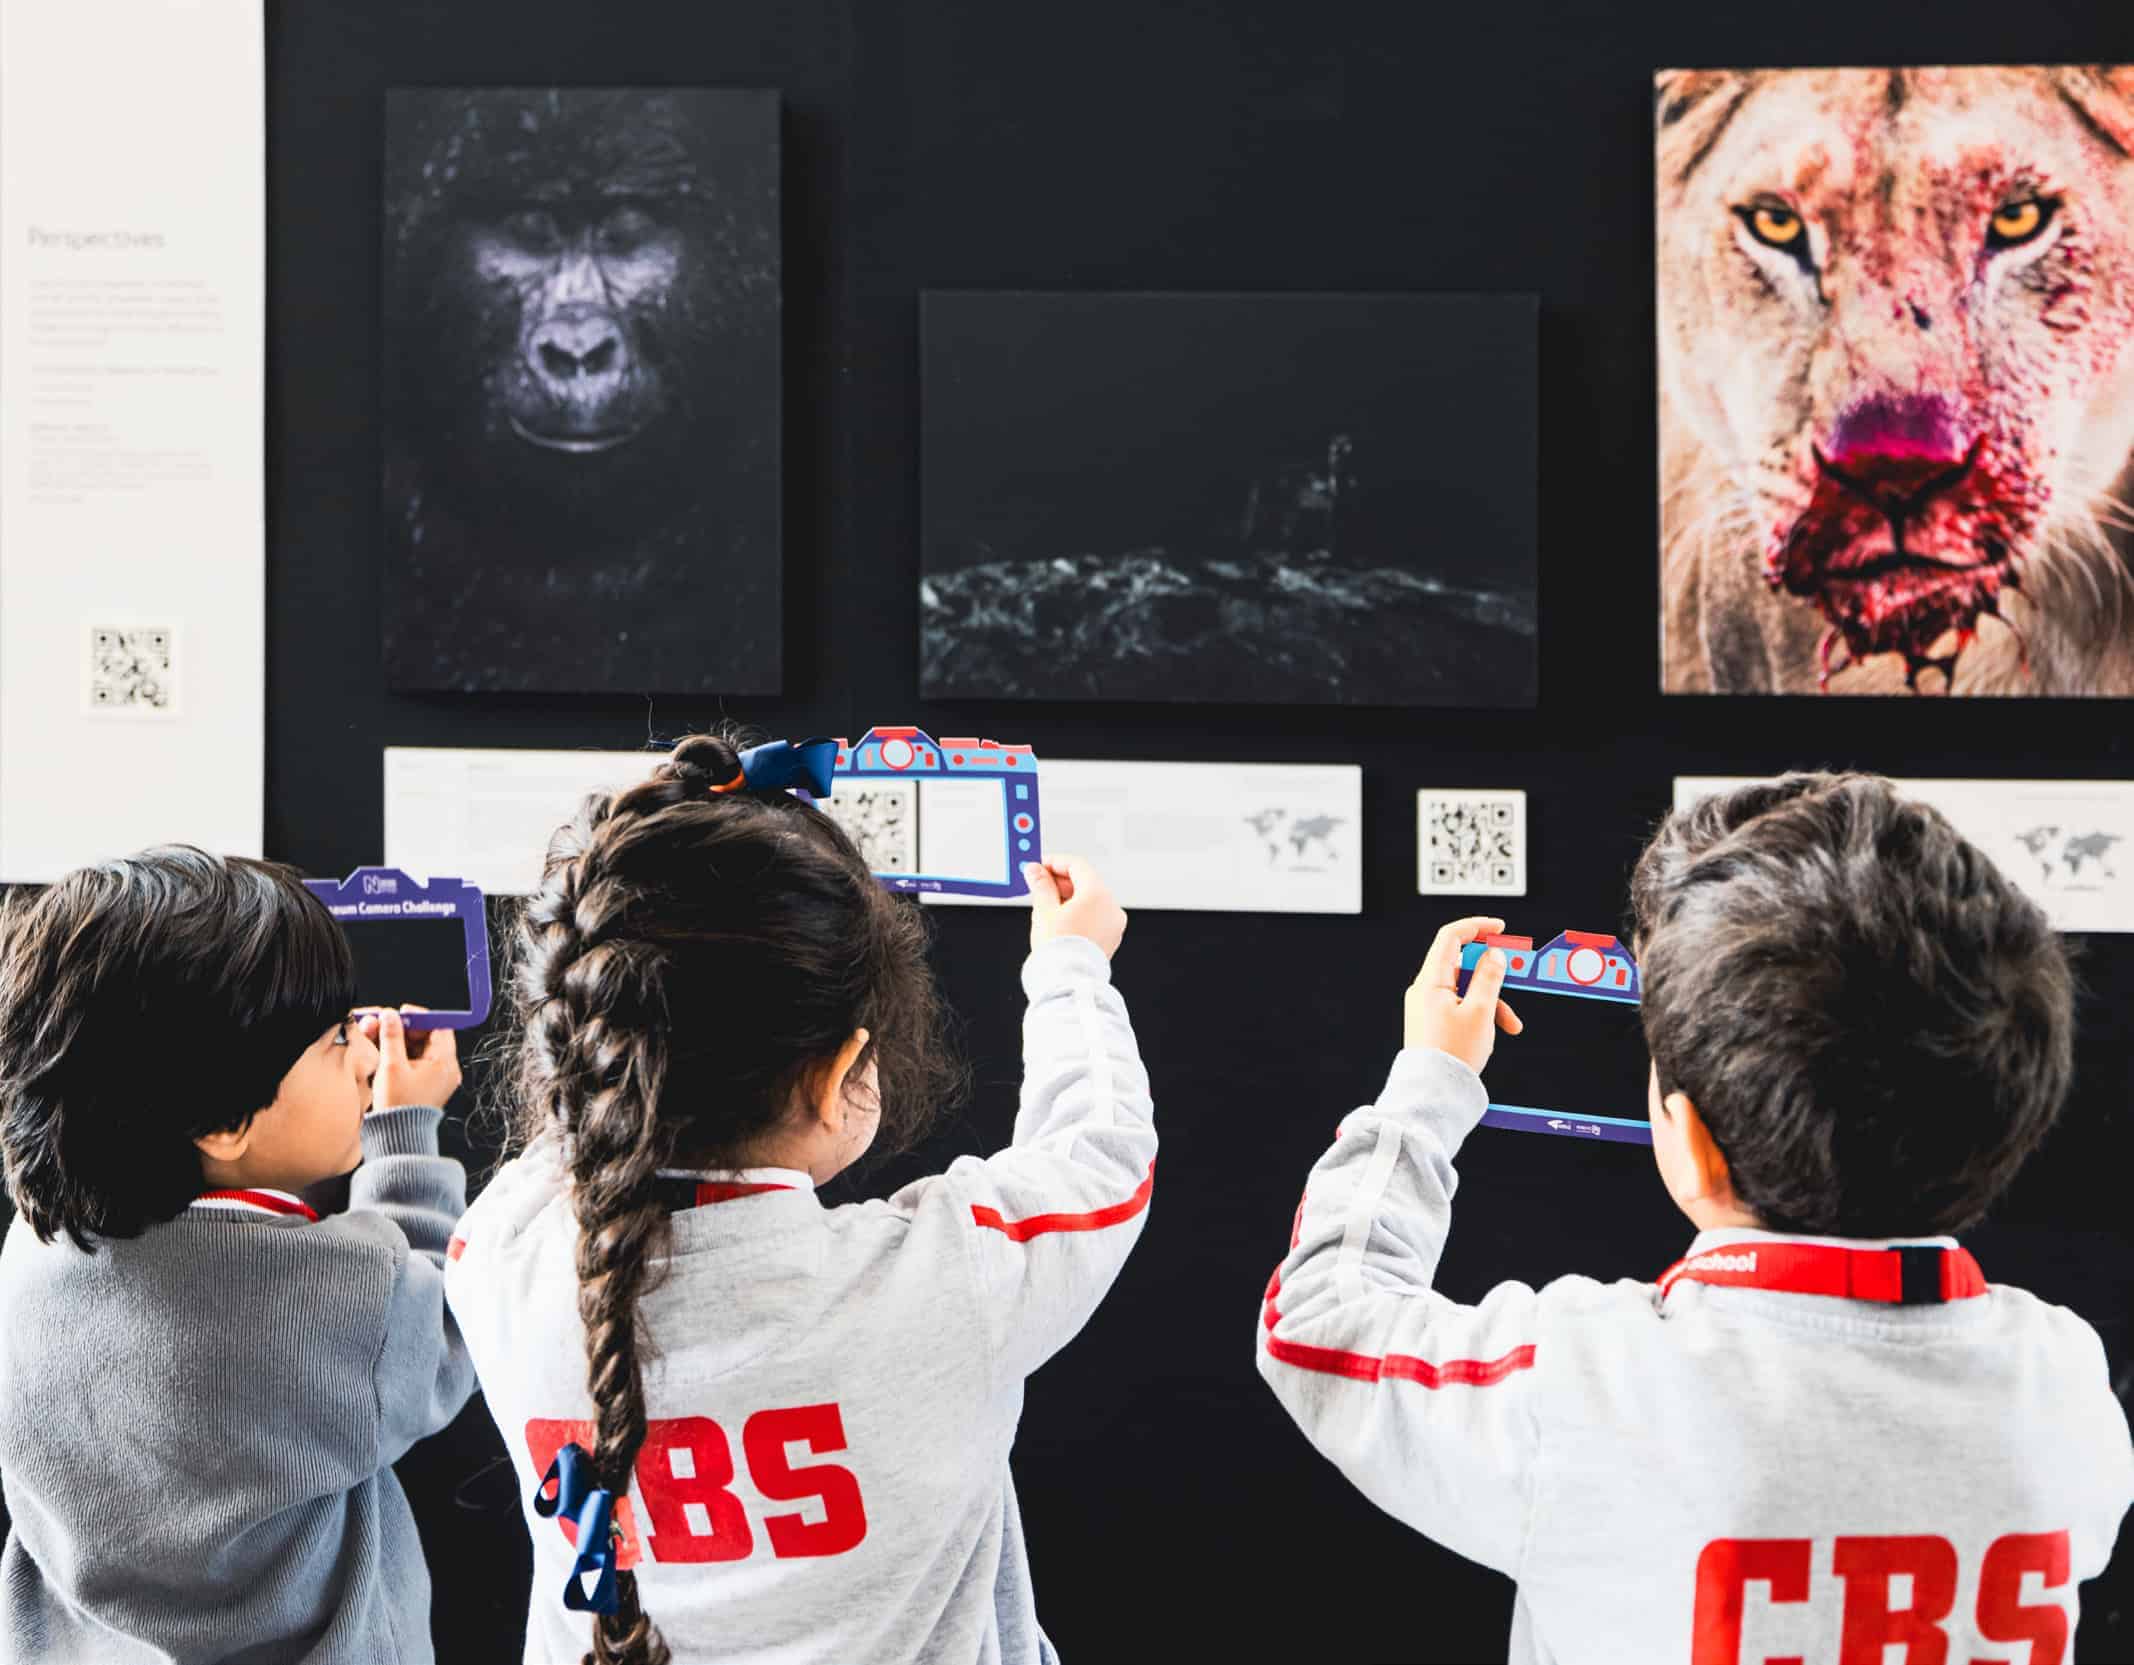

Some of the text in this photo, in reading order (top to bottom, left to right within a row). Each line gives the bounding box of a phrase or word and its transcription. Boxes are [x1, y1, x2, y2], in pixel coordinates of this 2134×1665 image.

[359, 901, 400, 914] Camera
[402, 900, 456, 917] Challenge
[1691, 1530, 2071, 1665] CBS
